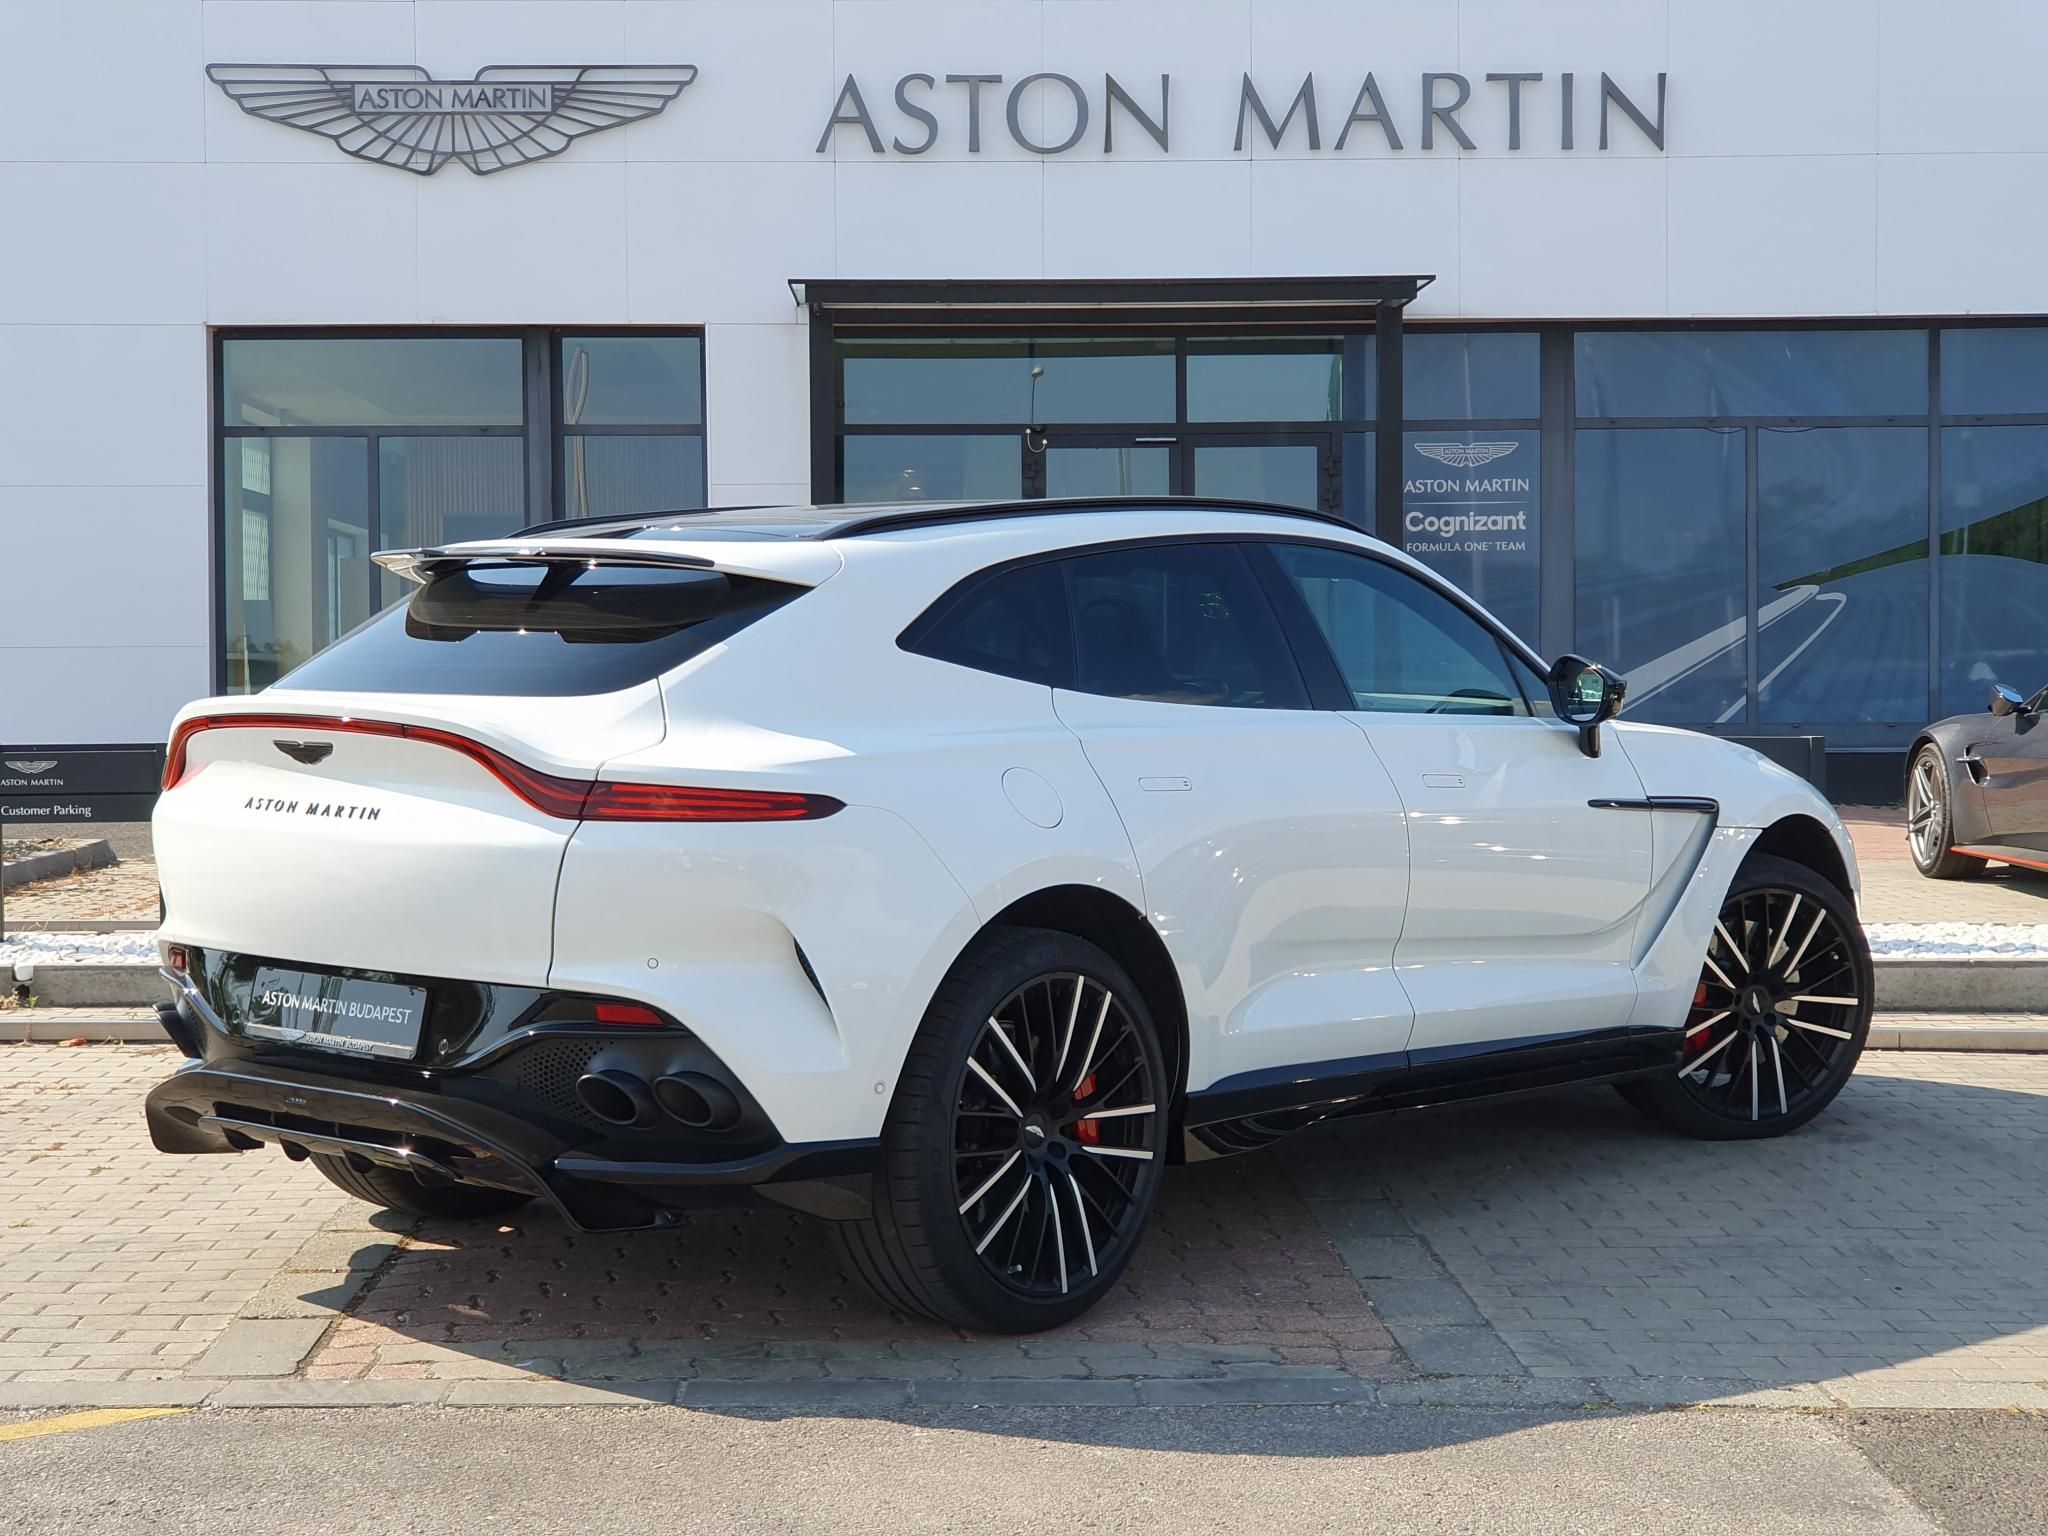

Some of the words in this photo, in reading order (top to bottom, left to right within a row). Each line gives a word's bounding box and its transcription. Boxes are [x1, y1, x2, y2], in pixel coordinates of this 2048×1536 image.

[358, 87, 443, 109] ASTON
[450, 87, 547, 109] MARTIN
[815, 72, 1170, 155] ASTON
[1233, 71, 1667, 153] MARTIN
[1403, 479, 1460, 493] ASTON
[1465, 478, 1529, 492] MARTIN
[1405, 511, 1527, 537] Cognizant
[1406, 542, 1461, 552] FORMULA
[1495, 541, 1526, 551] TEAM
[0, 778, 28, 786] ASTON
[30, 778, 64, 786] MARTIN
[1, 805, 51, 816] Customer
[53, 804, 92, 817] Parking
[244, 797, 298, 813] ASTON
[305, 802, 381, 820] MARTIN
[261, 990, 299, 1009] ASTON
[301, 996, 346, 1015] MARTIN
[348, 1002, 412, 1024] BUDAPEST
[305, 1035, 323, 1045] ASTON
[323, 1037, 345, 1048] MARTIN
[345, 1040, 374, 1052] BUDAPEST
